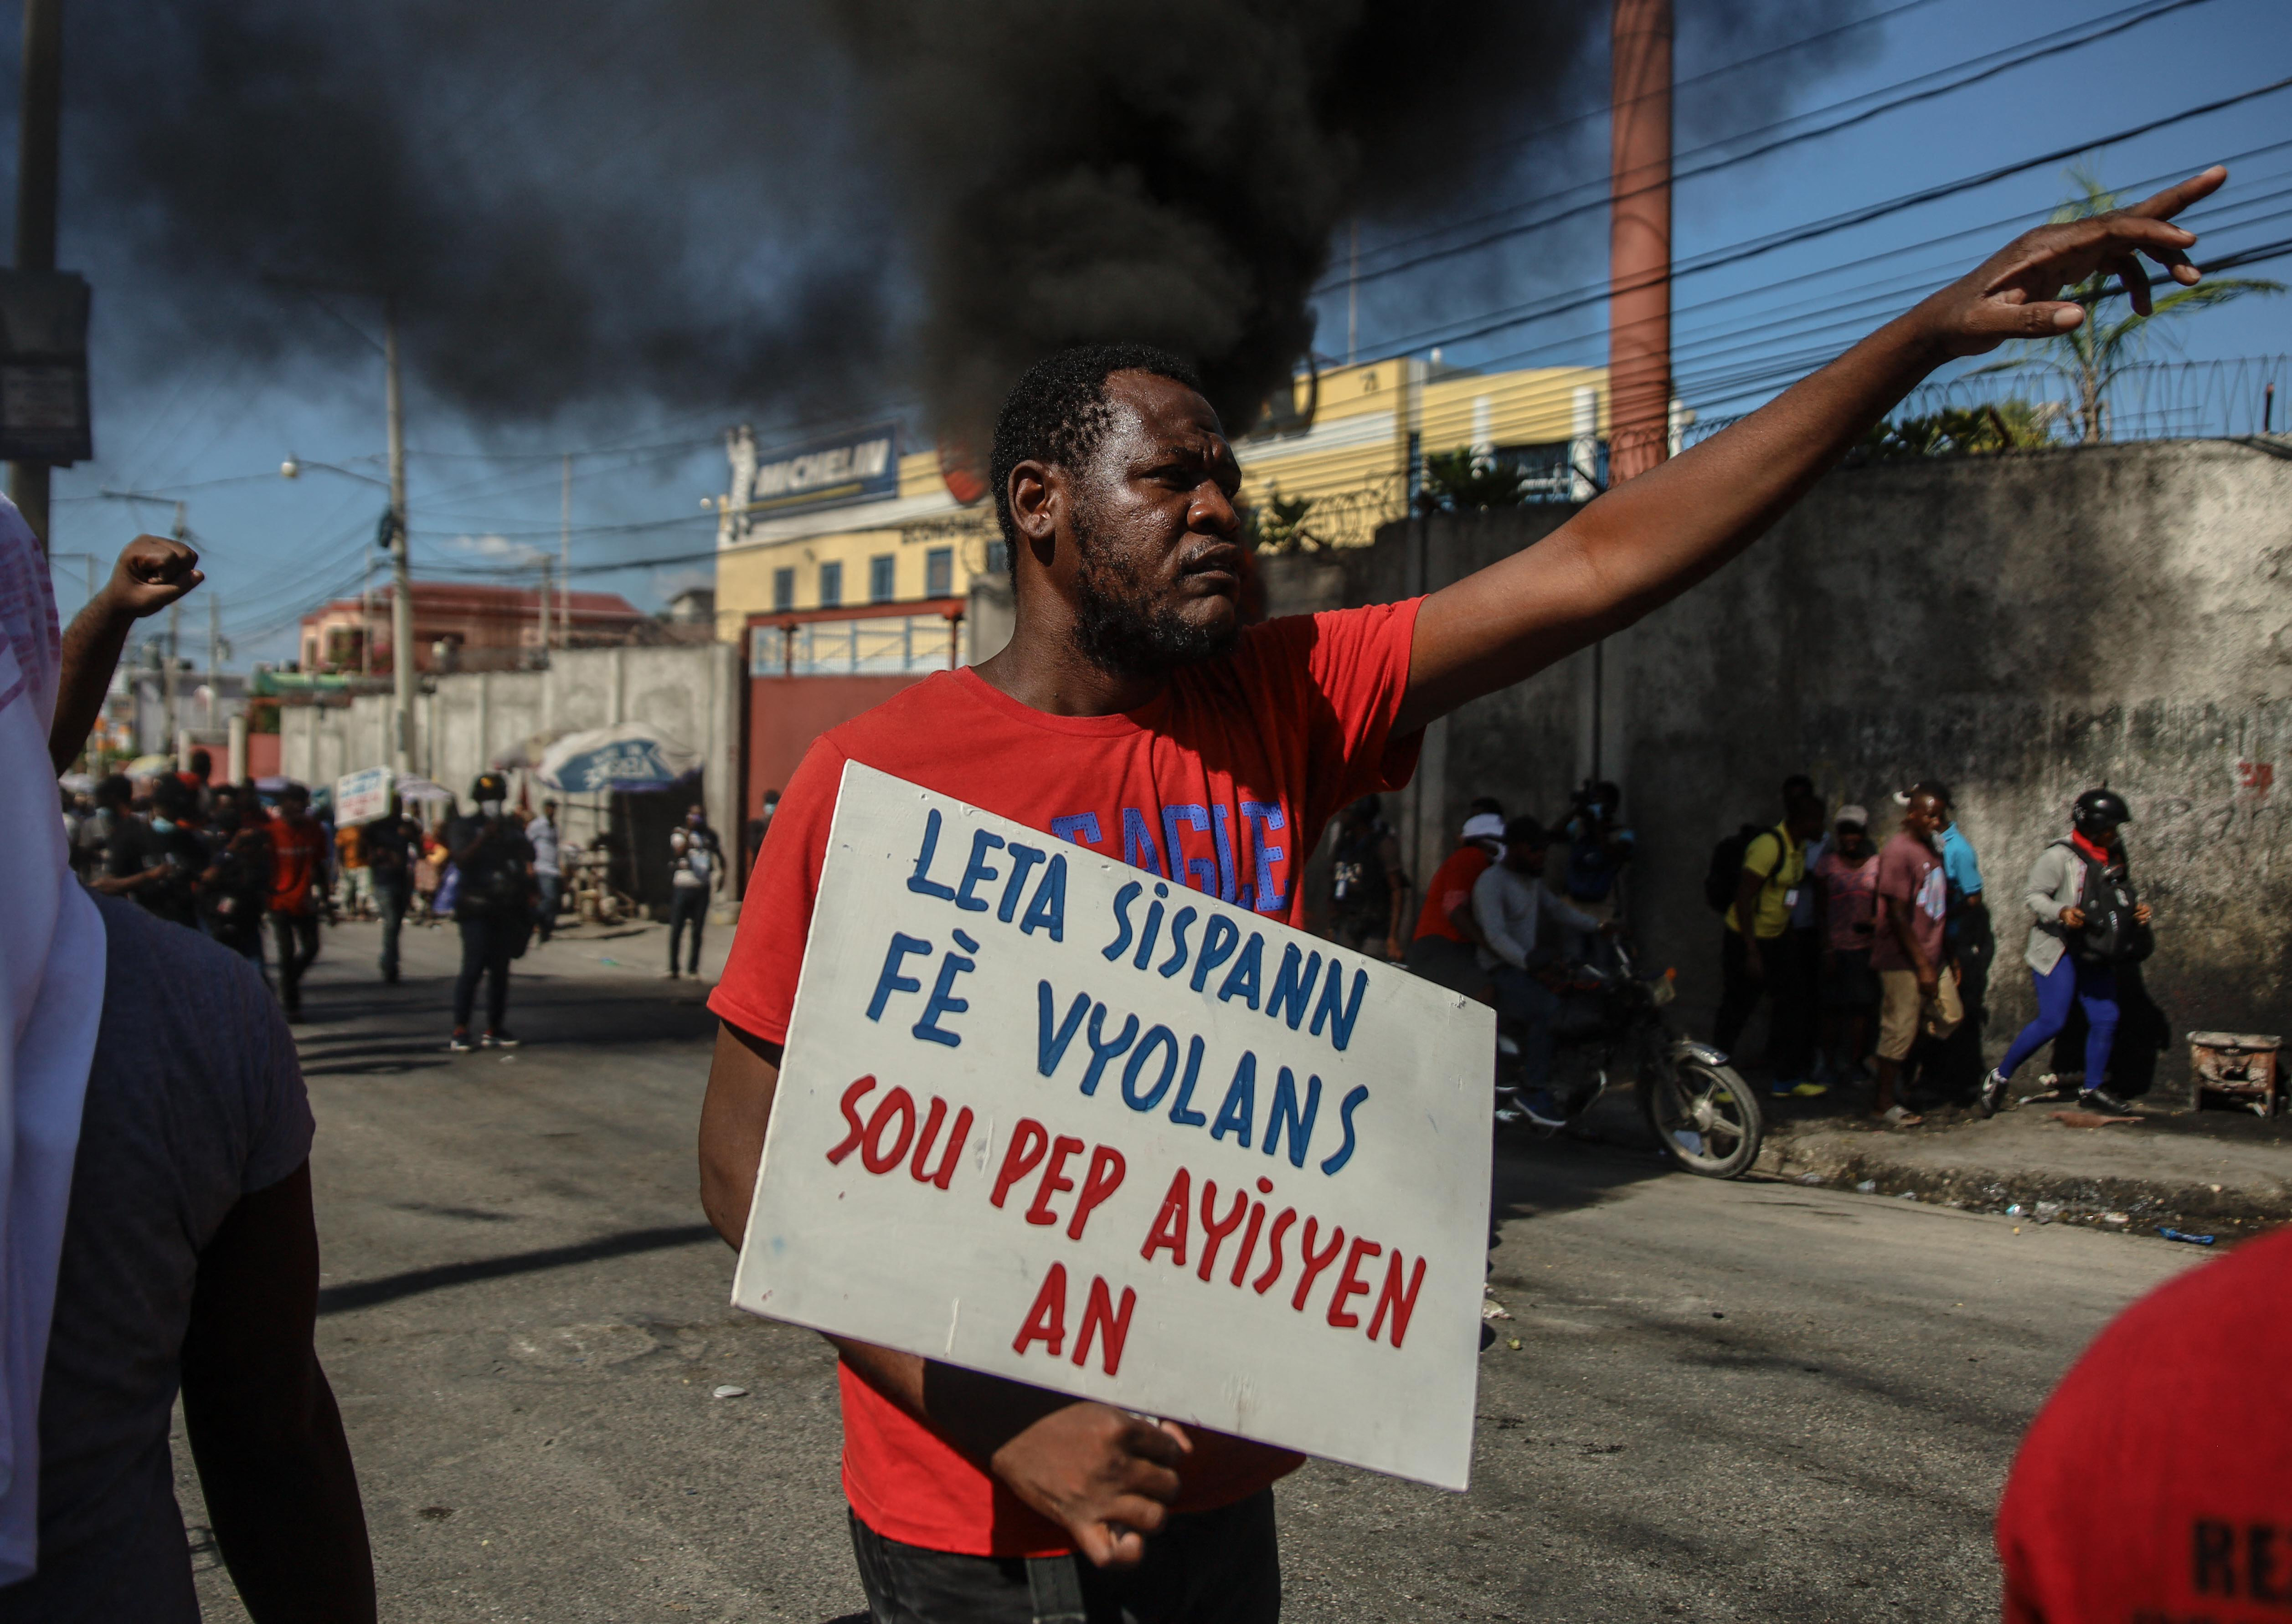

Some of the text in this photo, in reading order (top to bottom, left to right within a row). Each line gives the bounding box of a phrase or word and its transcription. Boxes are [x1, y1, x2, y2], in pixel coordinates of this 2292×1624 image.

[754, 437, 890, 497] MICHELIN
[907, 808, 1067, 943] LETA
[866, 929, 1369, 1177] FÈ VYOLANS
[826, 1074, 974, 1191] SOU
[990, 1117, 1126, 1241] PEP
[1012, 1261, 1137, 1376] AN
[2193, 1519, 2292, 1603] RE
